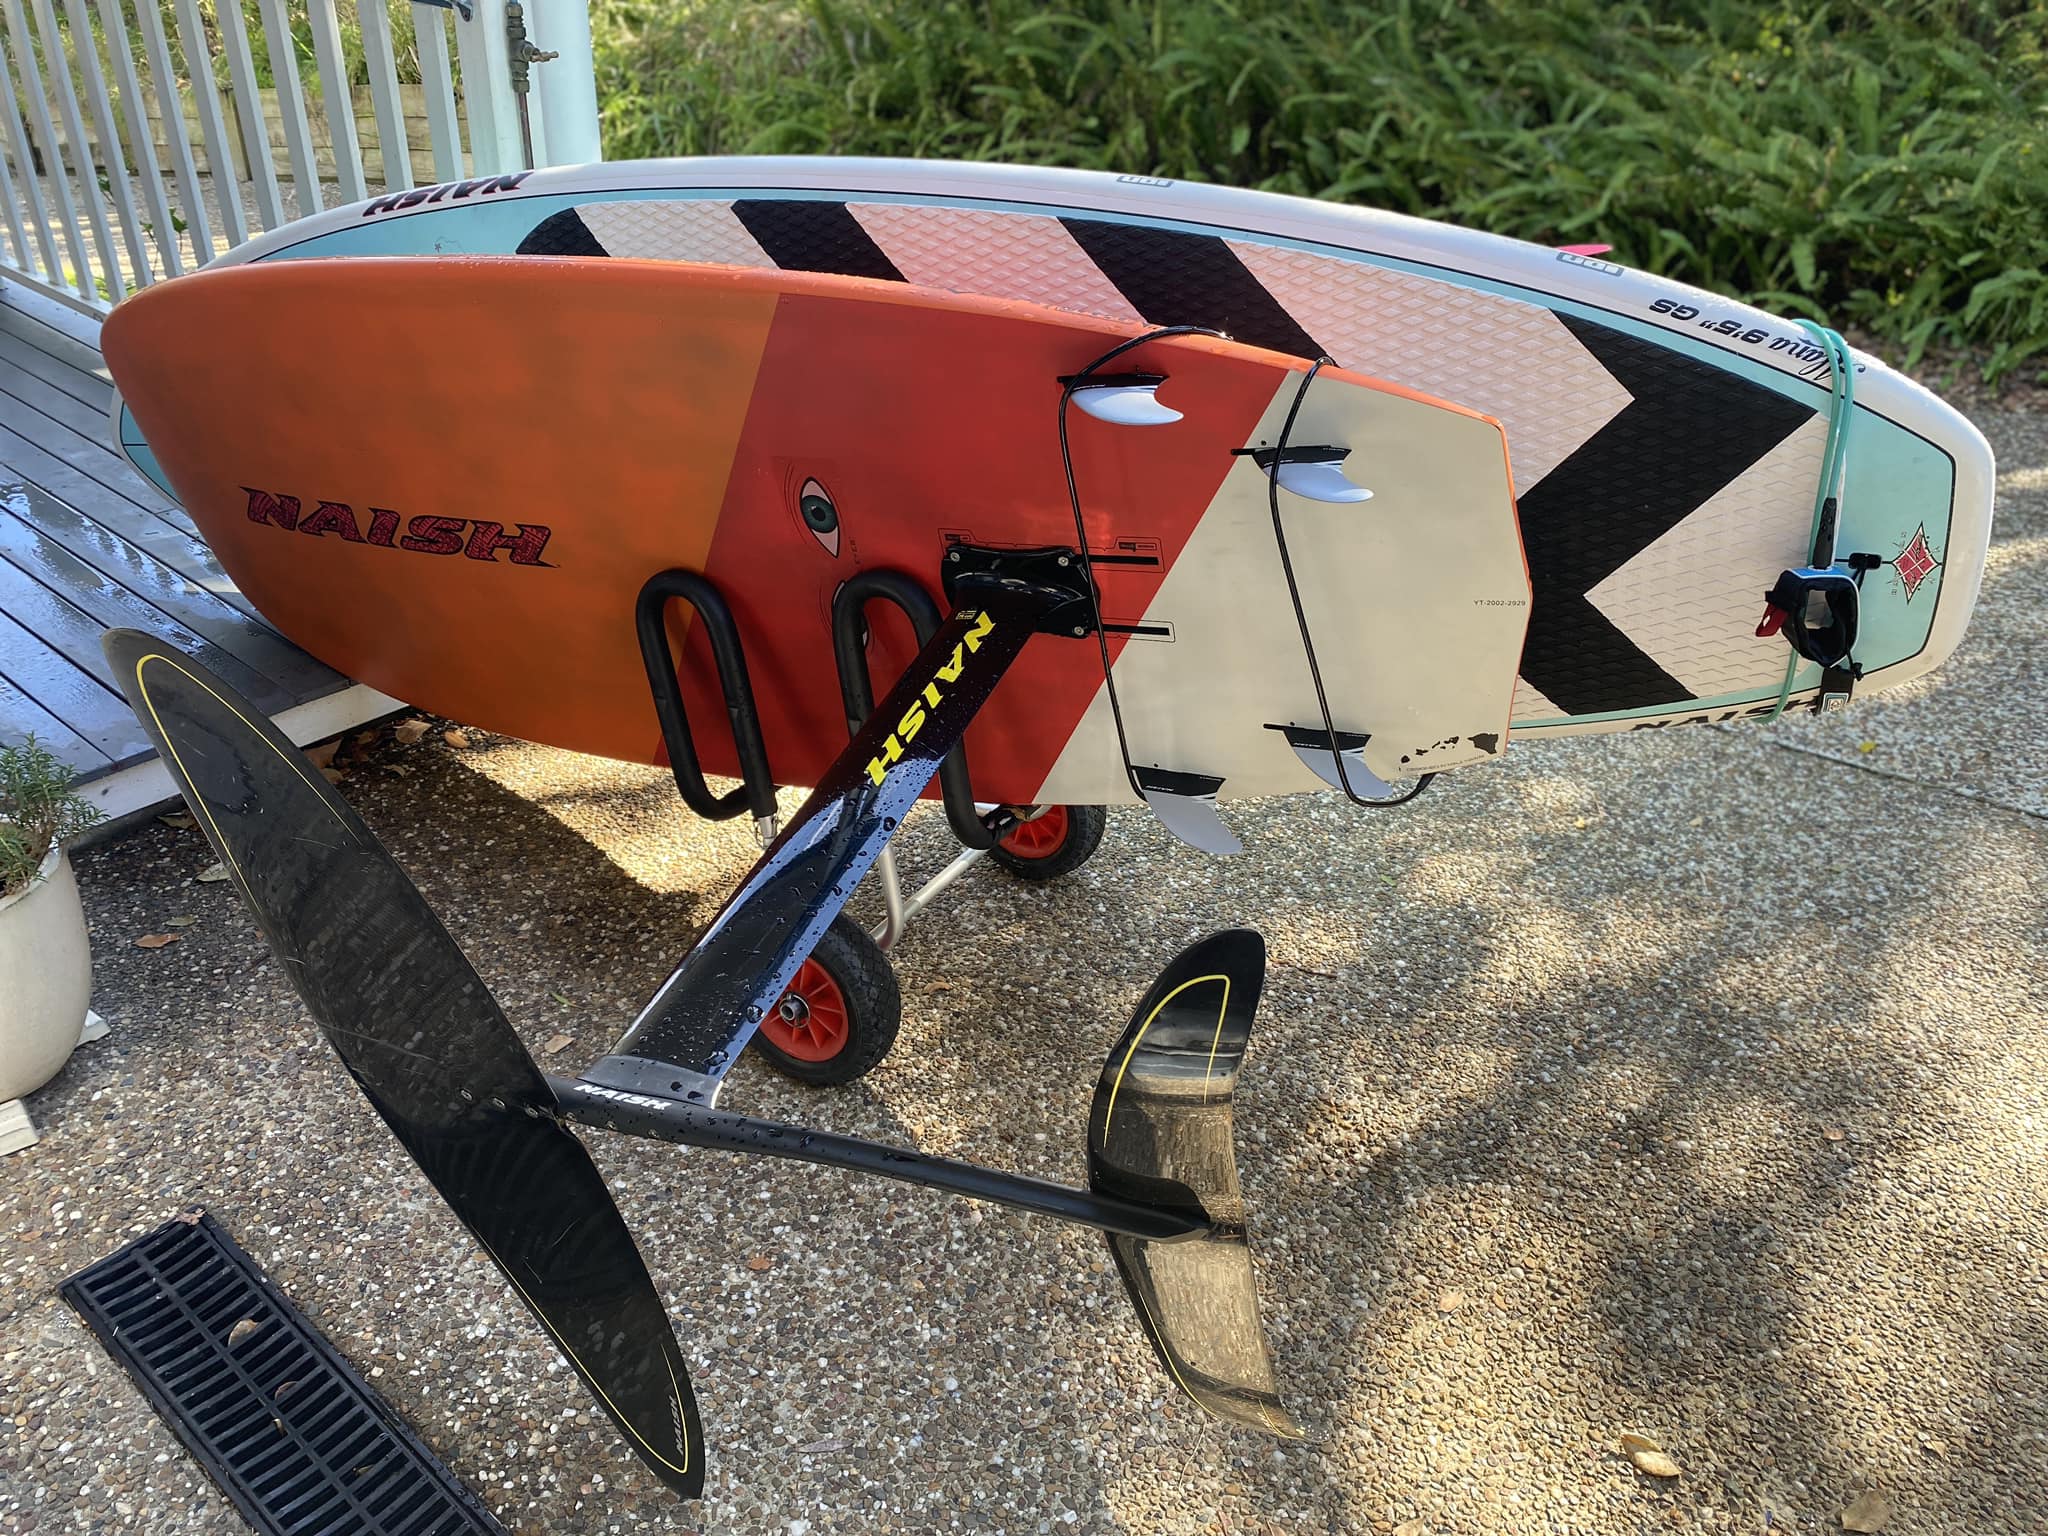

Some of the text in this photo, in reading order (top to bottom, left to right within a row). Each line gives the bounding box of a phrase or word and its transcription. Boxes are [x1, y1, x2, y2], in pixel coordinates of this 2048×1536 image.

[362, 171, 535, 217] NAISH
[1649, 299, 1700, 321] GS
[239, 486, 561, 568] NAISH
[864, 611, 996, 786] NAISH
[573, 1084, 672, 1110] NAISH
